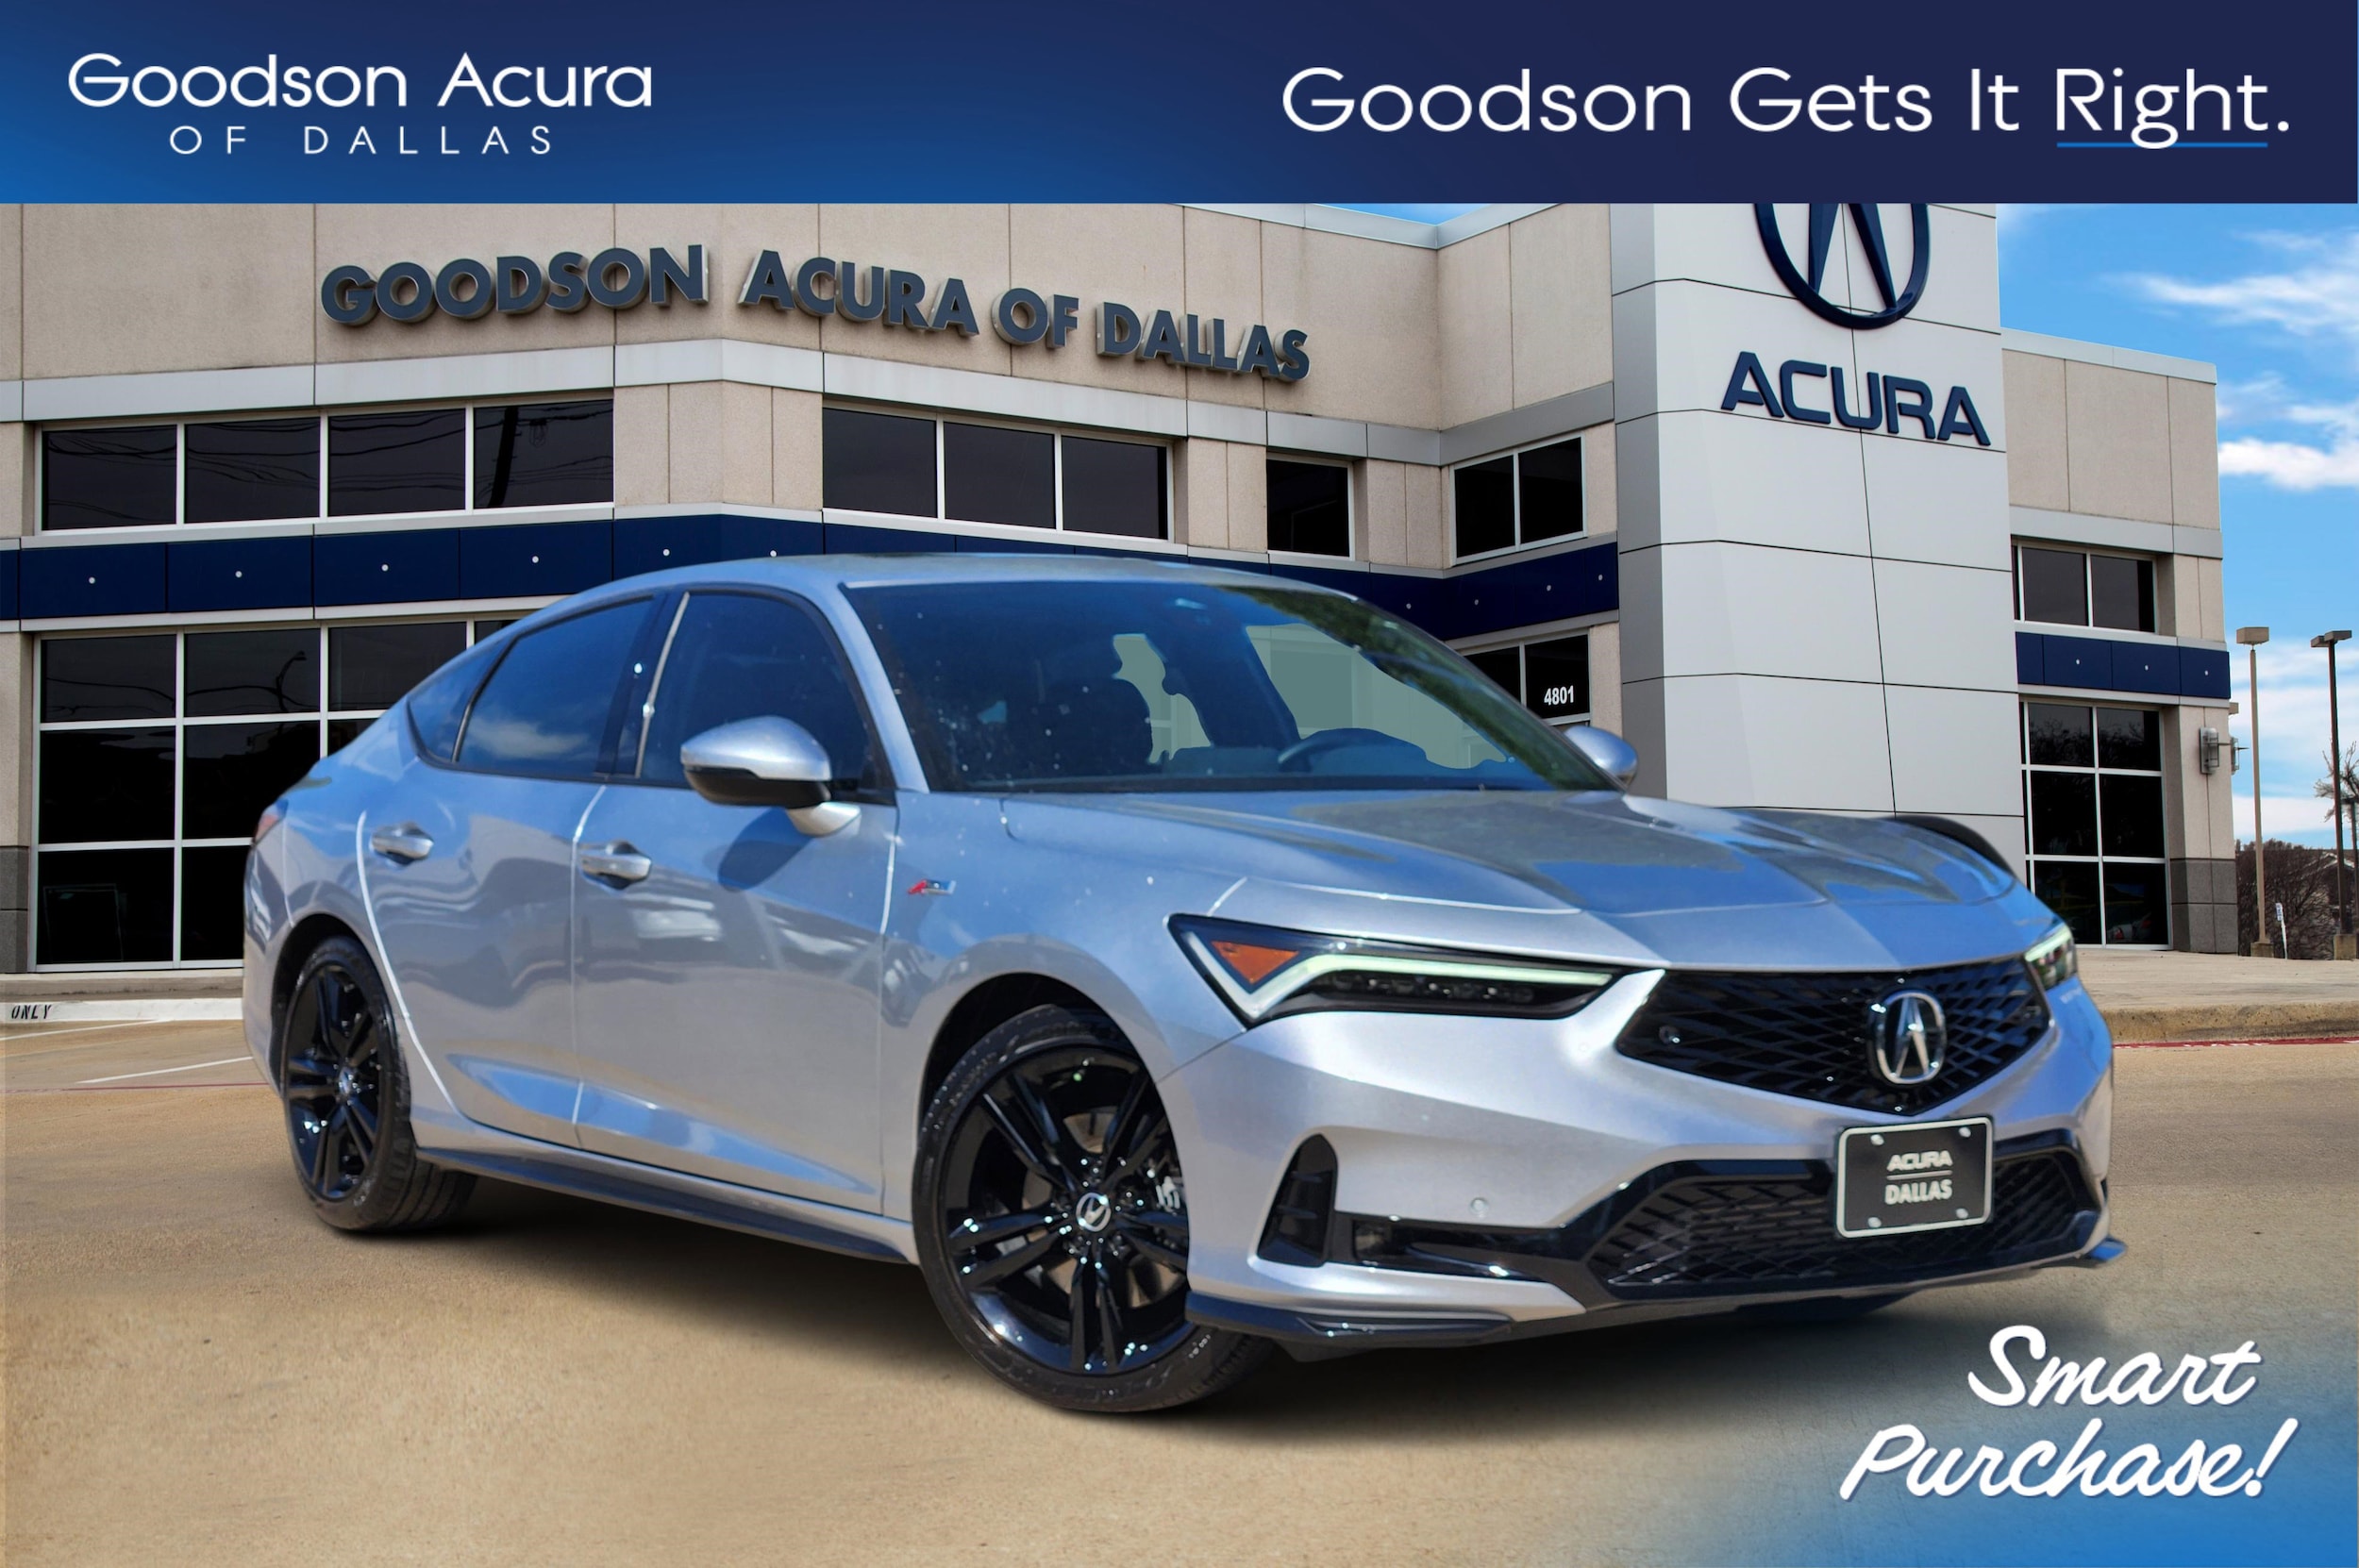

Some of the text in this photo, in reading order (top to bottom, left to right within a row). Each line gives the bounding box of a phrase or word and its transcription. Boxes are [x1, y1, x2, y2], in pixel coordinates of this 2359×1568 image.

[321, 244, 1311, 382] GOODSON ACURA OF DALLAS
[1721, 351, 1991, 446] ACURA
[1544, 685, 1574, 706] 4801
[10, 1004, 52, 1020] ONLY
[1886, 1150, 1953, 1172] ACURA
[1884, 1179, 1952, 1205] DALLAS
